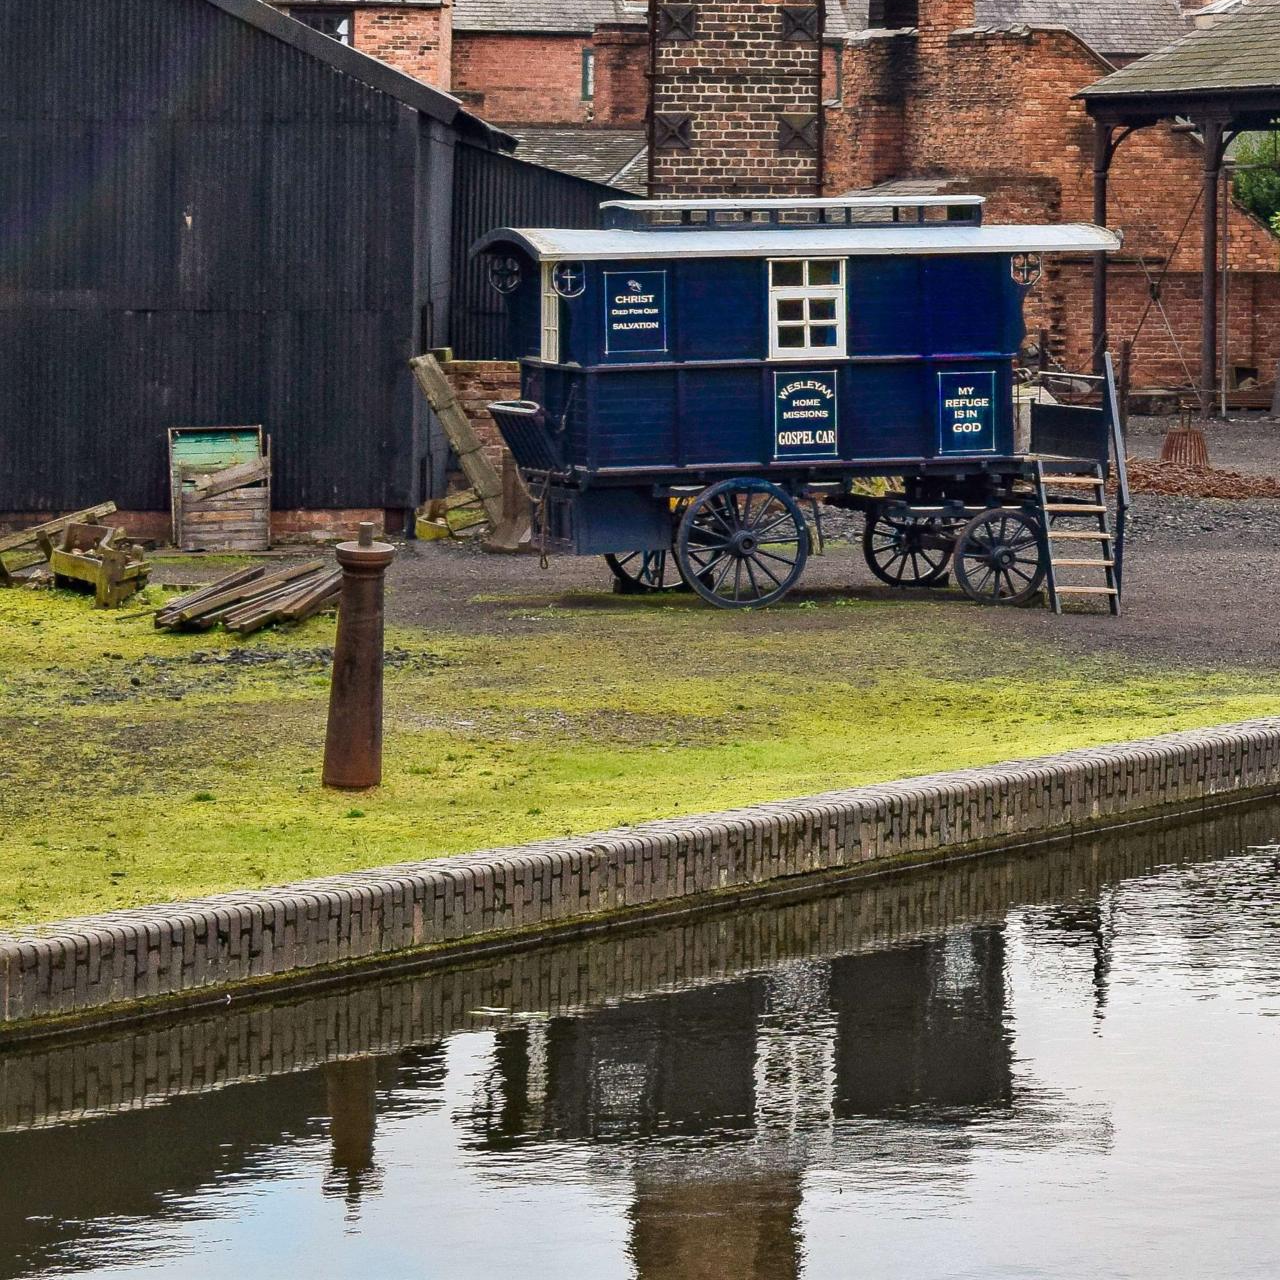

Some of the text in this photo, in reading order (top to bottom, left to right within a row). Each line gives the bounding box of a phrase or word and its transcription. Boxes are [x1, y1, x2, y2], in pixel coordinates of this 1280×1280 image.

[615, 294, 655, 304] CHRIST
[612, 321, 659, 330] SALVATION
[778, 380, 834, 400] WESLEYAN
[958, 386, 975, 396] MY
[792, 399, 821, 407] HOME
[945, 398, 990, 408] REFUGE
[783, 410, 829, 419] MISSIONS
[954, 409, 978, 419] IS IN
[952, 422, 982, 433] GOD
[778, 430, 835, 446] GOSPEL CAR
